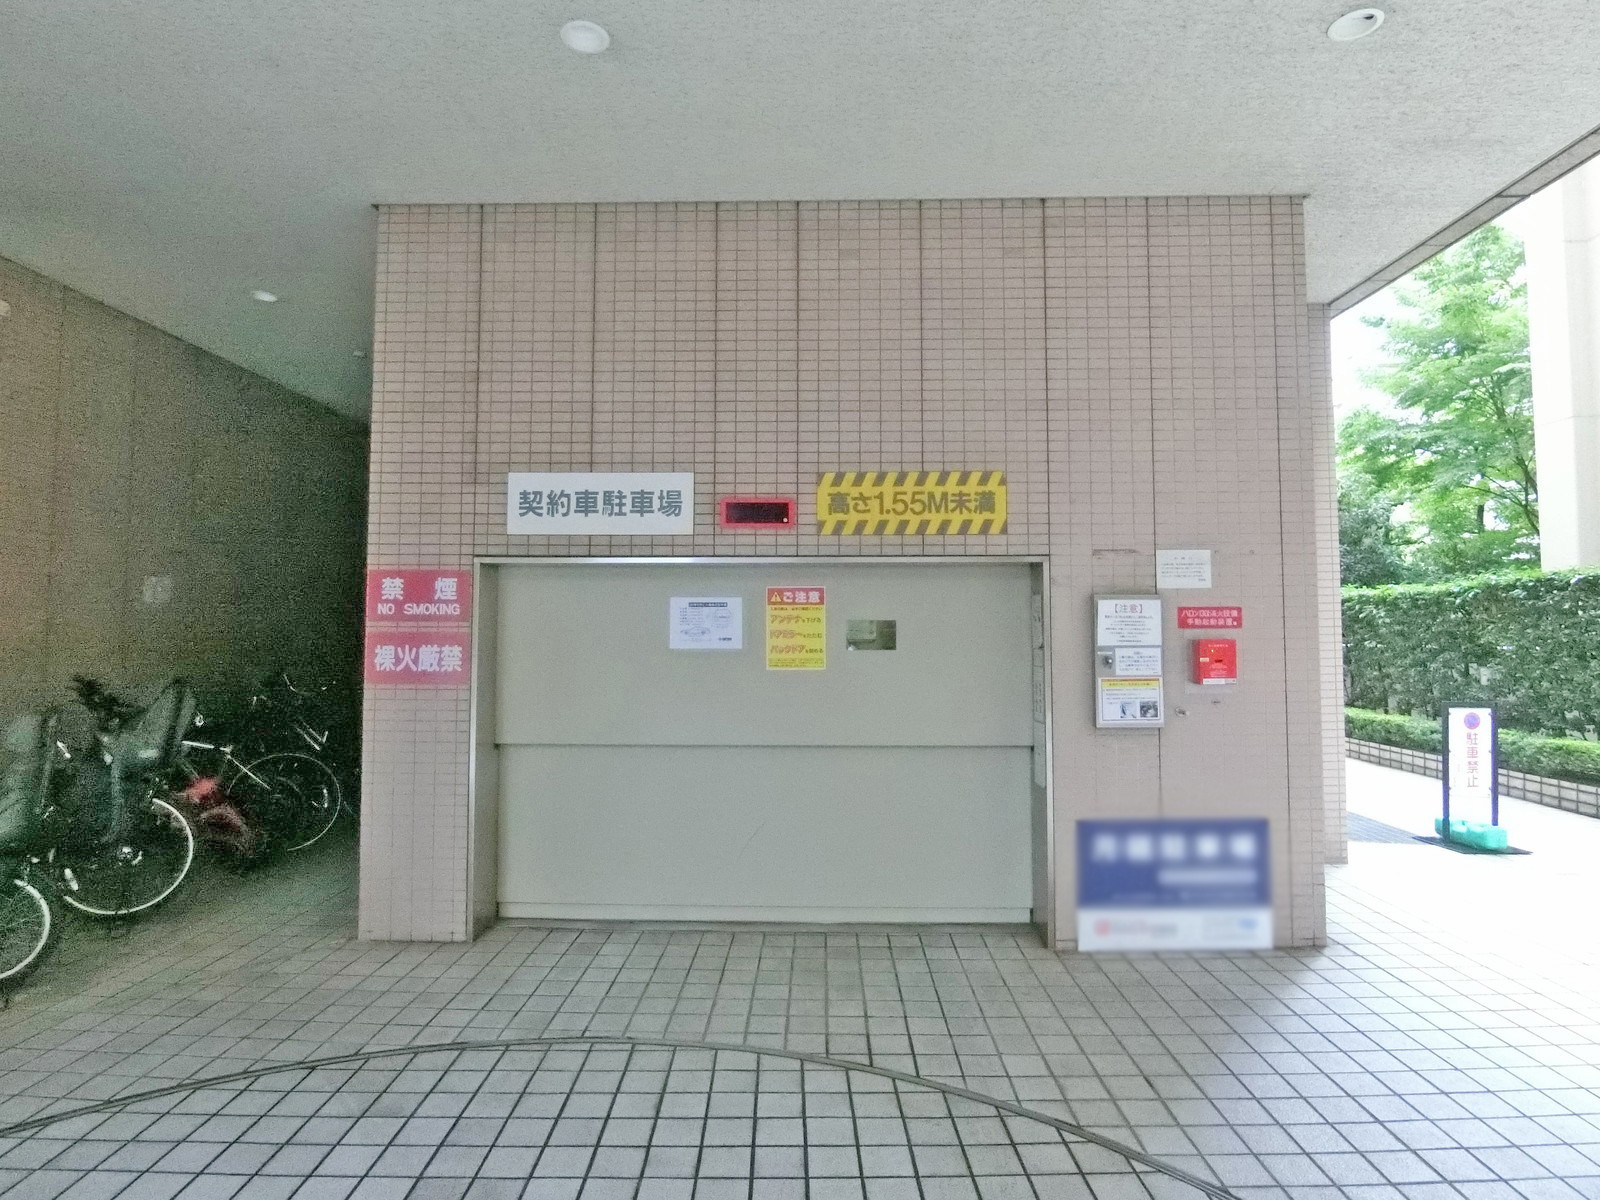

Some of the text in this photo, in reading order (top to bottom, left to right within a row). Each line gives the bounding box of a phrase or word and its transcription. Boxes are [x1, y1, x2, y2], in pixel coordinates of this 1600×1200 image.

[518, 489, 683, 517] 契約車駐車場
[828, 491, 996, 515] 高さ1.55M未満
[377, 603, 461, 615] NO SMOKING
[783, 591, 820, 603] ご注意
[374, 644, 463, 672] 裸火厳禁
[1466, 732, 1479, 788] 駐車禁止
